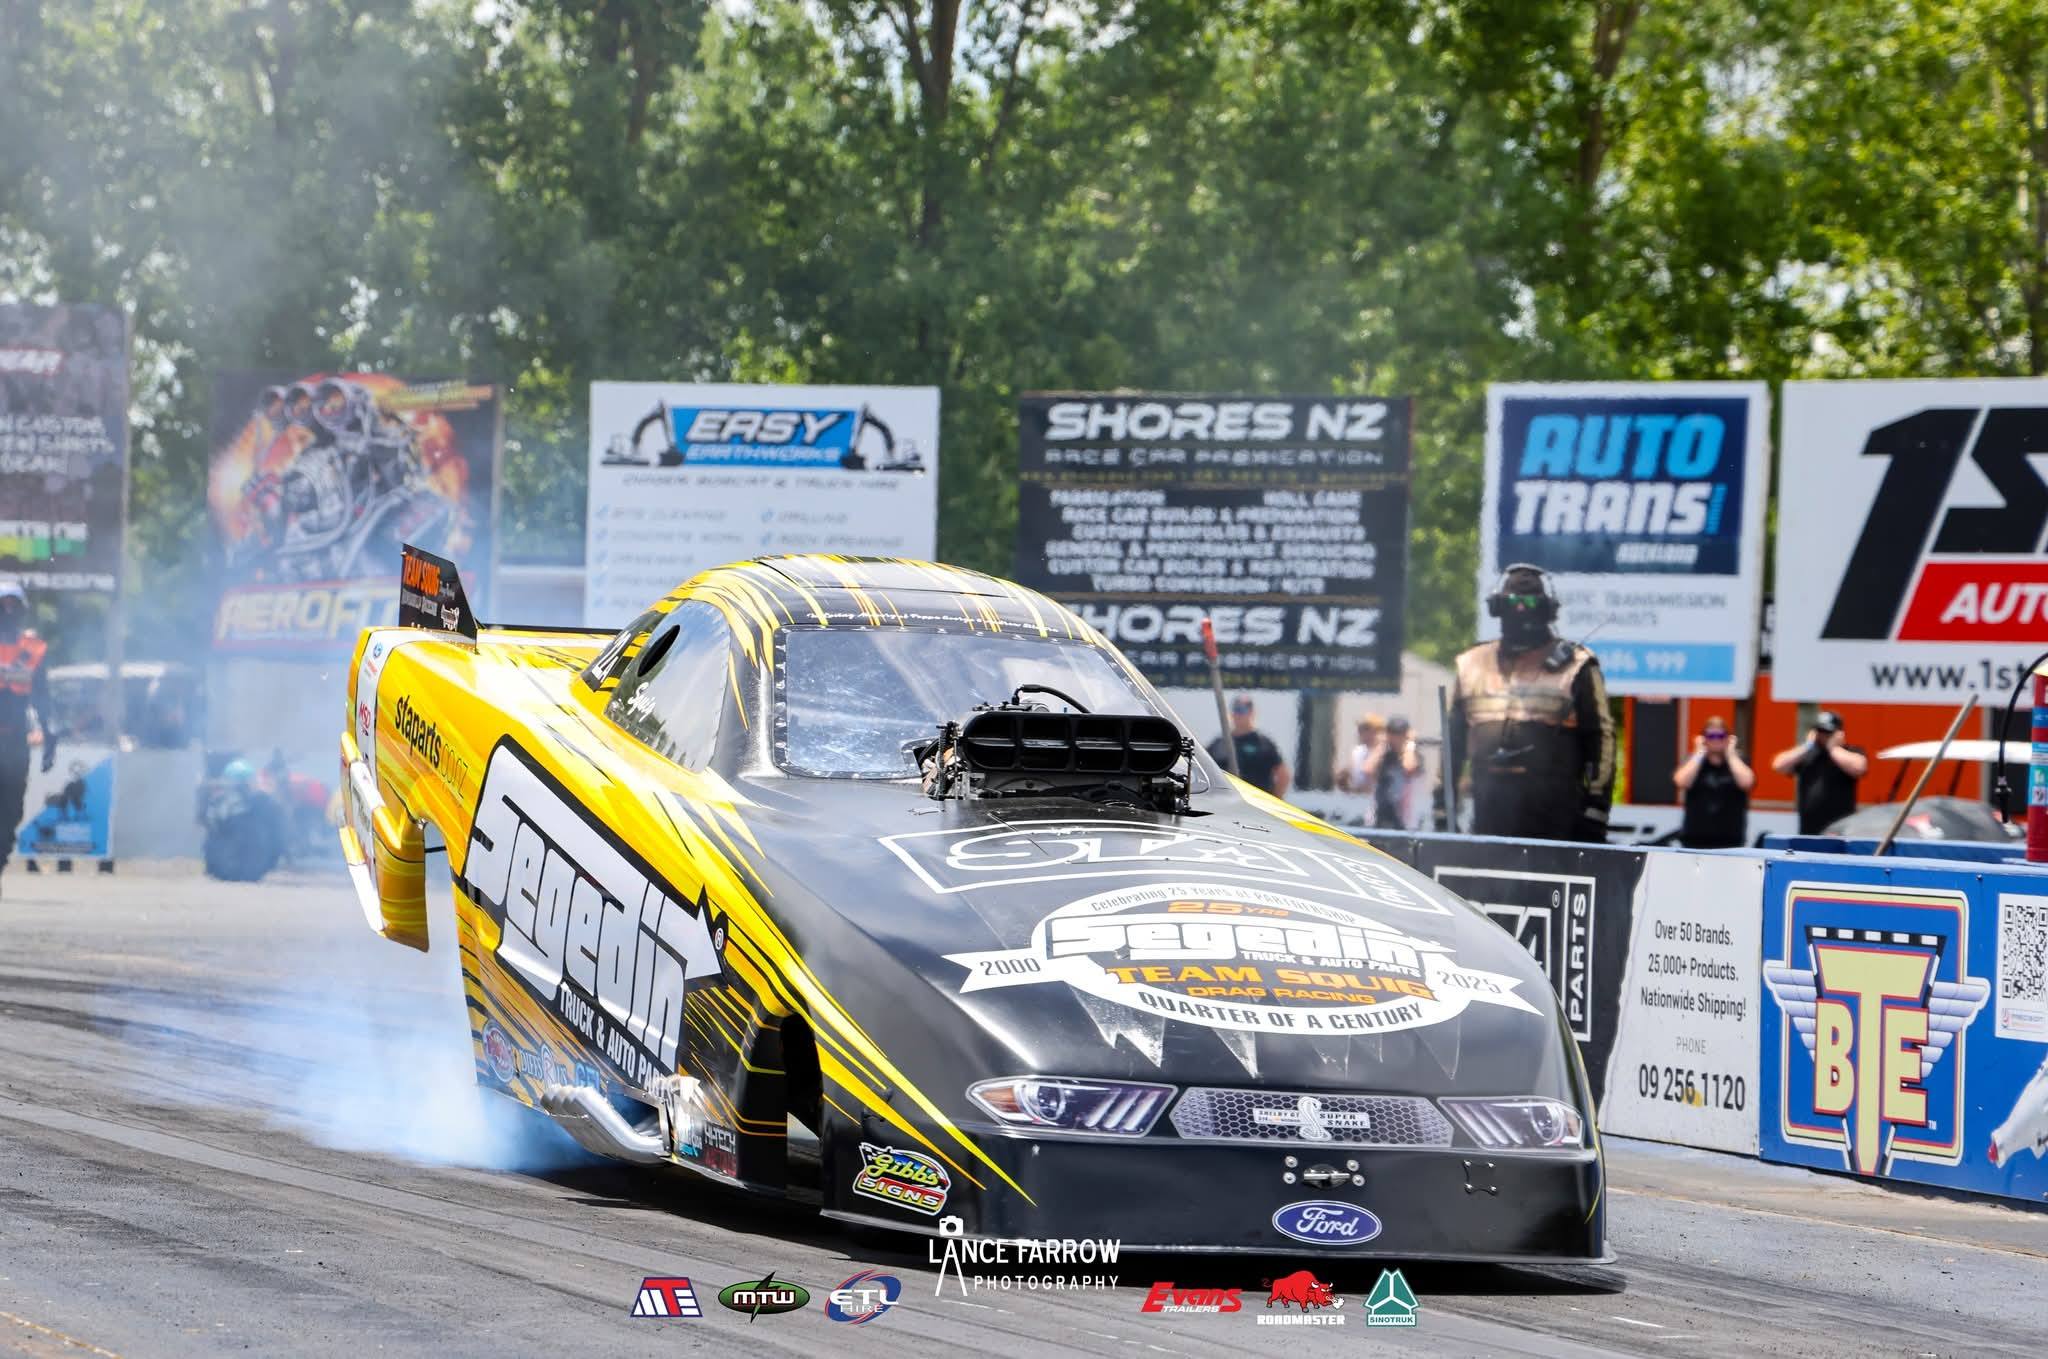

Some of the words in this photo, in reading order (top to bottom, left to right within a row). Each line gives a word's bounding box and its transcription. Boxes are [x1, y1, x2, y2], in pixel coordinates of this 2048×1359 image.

[687, 410, 840, 443] EASY
[1044, 402, 1293, 442] SHORES
[1306, 403, 1388, 442] NZ
[1520, 413, 1726, 479] AUTO
[1514, 479, 1713, 535] TRANS
[1068, 605, 1285, 646] HORES
[1297, 607, 1381, 647] NZ
[1872, 660, 2032, 690] www.1st
[465, 744, 722, 1072] Segedin
[1090, 888, 1168, 913] Celebrating
[1049, 912, 1430, 971] Segedin
[1655, 919, 1678, 942] Over
[1680, 922, 1693, 943] 50
[1695, 922, 1734, 947] Brands.
[979, 956, 1042, 977] 2000
[1243, 951, 1298, 965] TRUCK
[1301, 954, 1315, 966] &
[1320, 957, 1368, 970] AUTO
[1368, 961, 1422, 978] PARTS
[1570, 892, 1587, 1023] PARTS
[1648, 952, 1688, 977] 25,000+
[1690, 955, 1740, 983] Products.
[1105, 965, 1263, 984] TEAM
[1275, 967, 1440, 1002] SQUIG
[1186, 985, 1267, 998] DRAG
[1272, 987, 1377, 1006] RACING
[1436, 970, 1503, 994] 2025
[1137, 990, 1261, 1025] QUARTER
[1267, 1011, 1297, 1029] OF
[1306, 1011, 1324, 1029] A
[1328, 1001, 1424, 1029] CENTURY
[1640, 985, 1696, 1012] Nationwide
[1698, 991, 1748, 1022] Shipping!
[559, 981, 595, 1045] TRUCK
[596, 1015, 606, 1051] &
[606, 1027, 636, 1079] AUTO
[636, 1055, 673, 1106] PAR
[1675, 1037, 1707, 1056] PHONE
[1638, 1063, 1659, 1100] 09
[1663, 1066, 1697, 1106] 256
[1700, 1073, 1746, 1112] 1120
[1327, 1119, 1365, 1127] SNAKE
[861, 1177, 941, 1207] SIGNS
[1295, 1206, 1360, 1238] Ford
